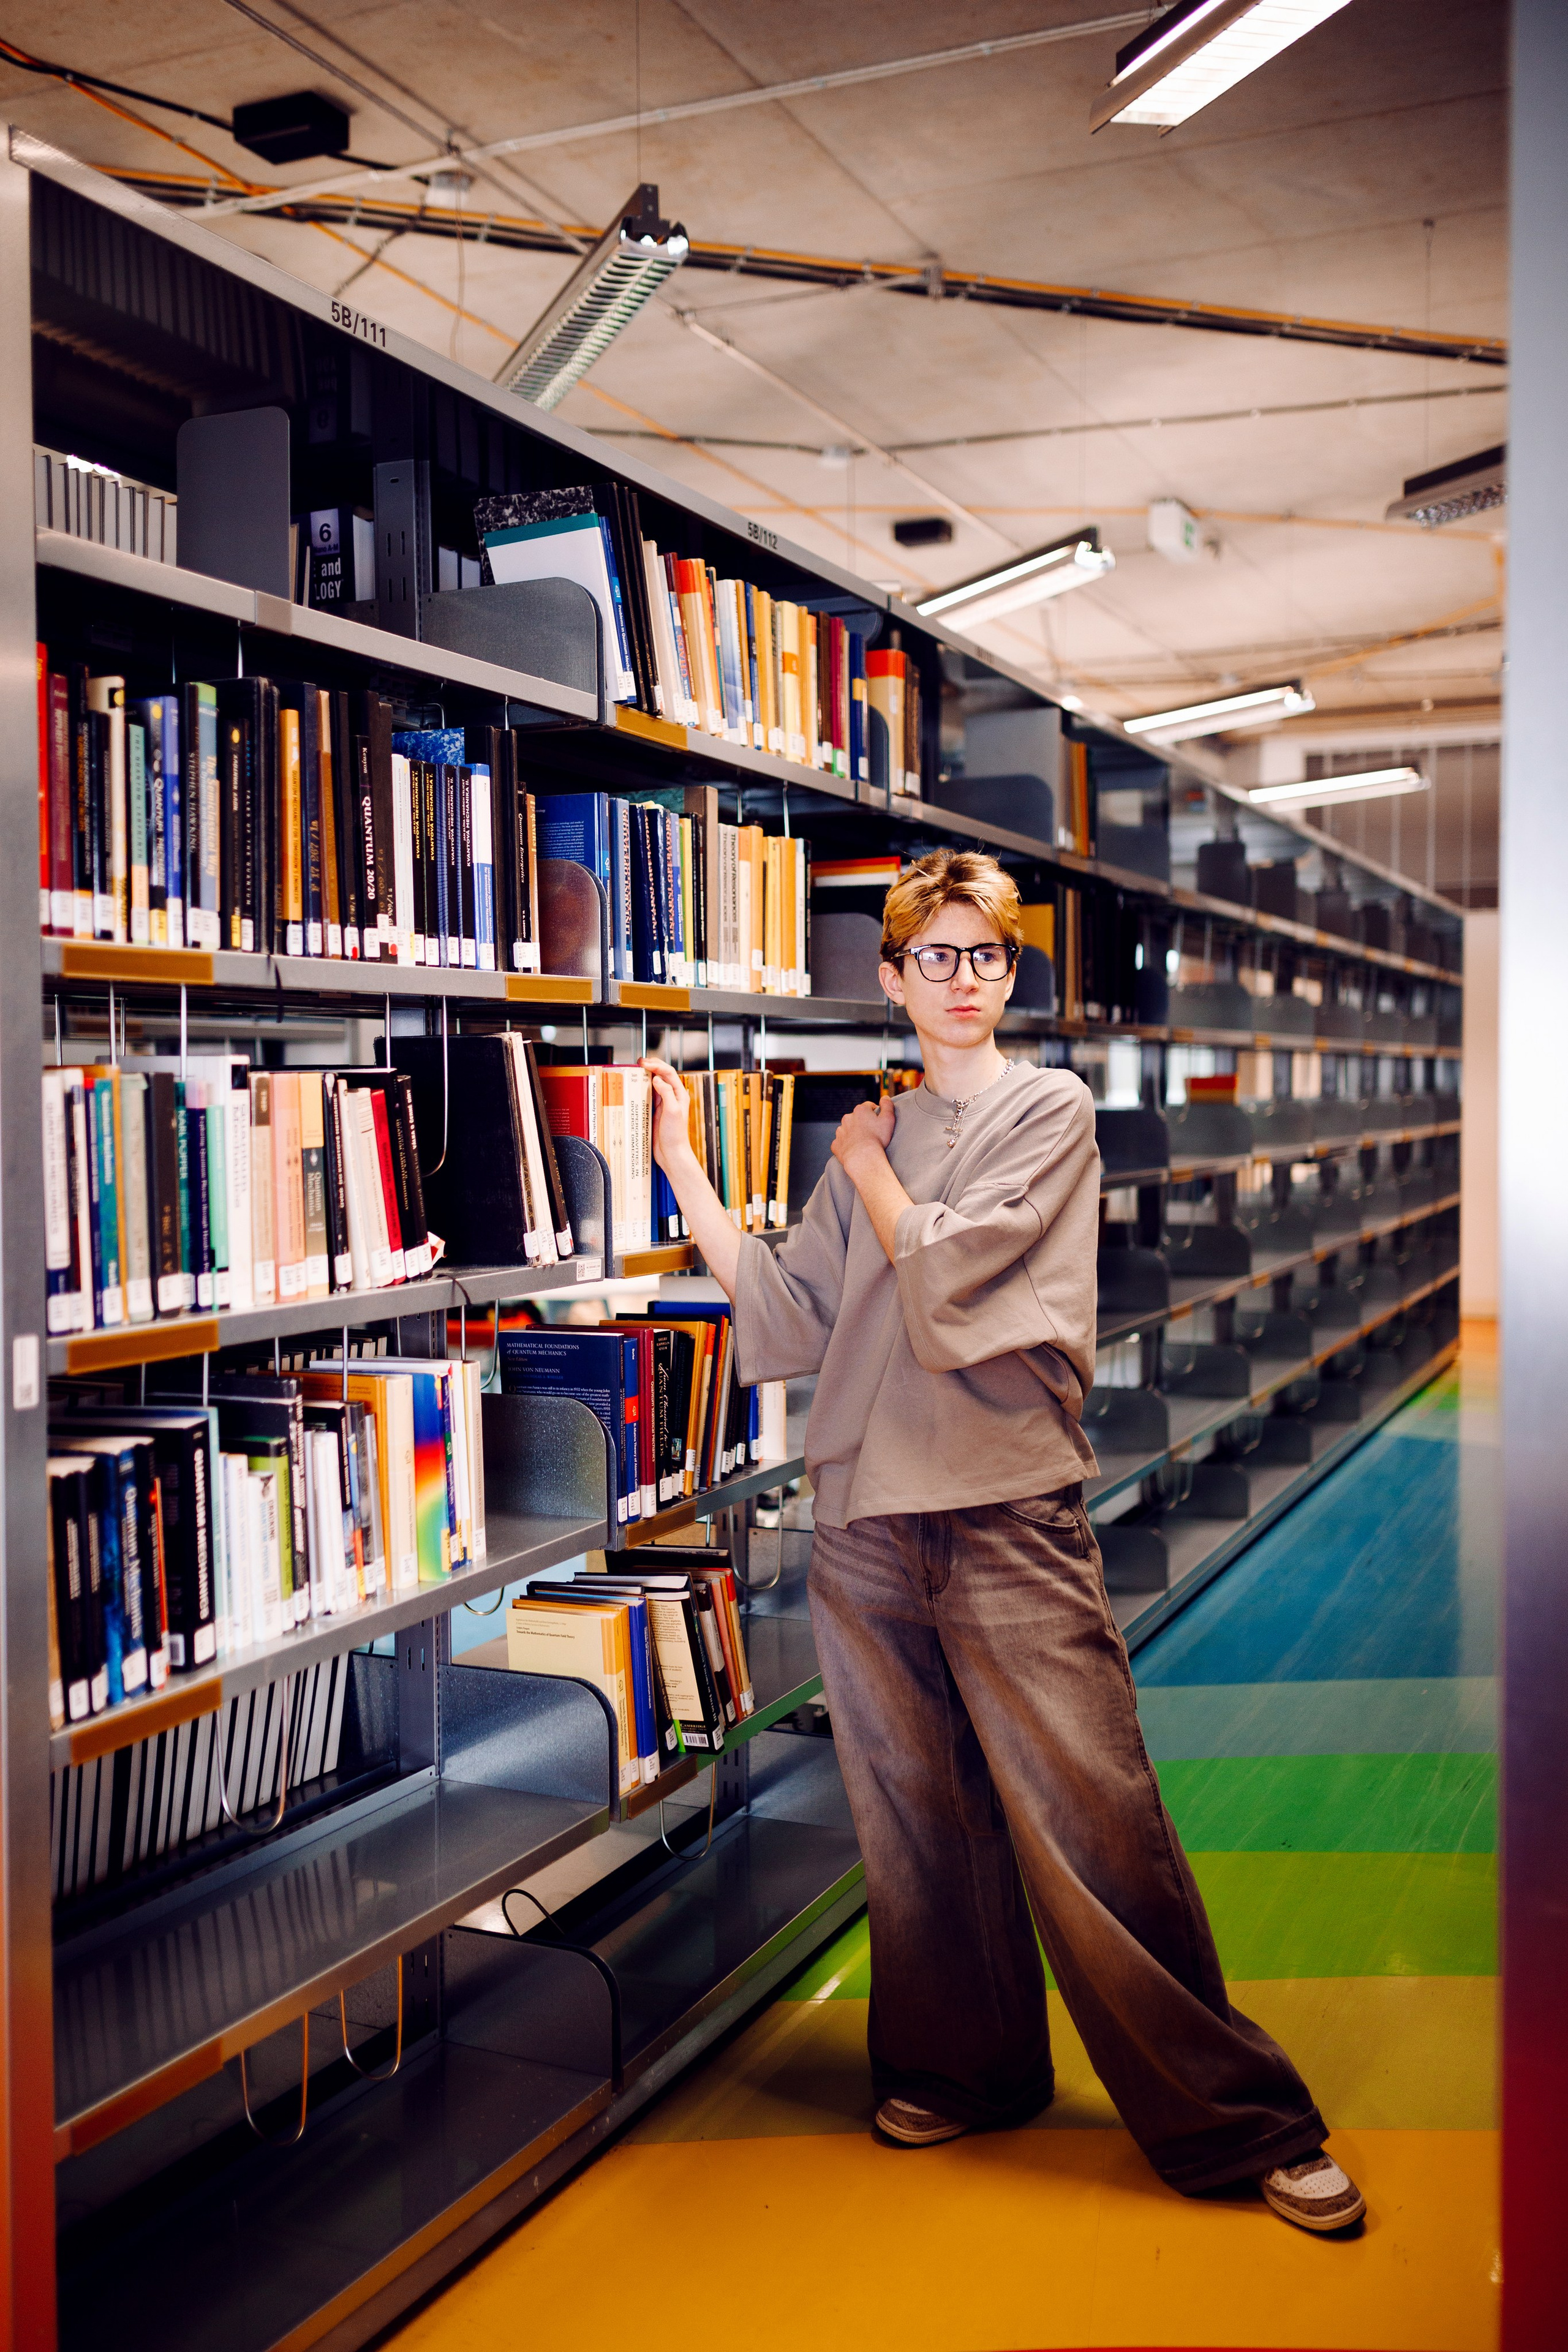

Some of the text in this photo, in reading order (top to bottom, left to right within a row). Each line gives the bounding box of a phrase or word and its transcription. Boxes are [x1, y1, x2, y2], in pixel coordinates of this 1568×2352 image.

[331, 302, 386, 347] 5B/111
[320, 523, 331, 542] 6
[748, 522, 777, 549] 5B/112
[322, 557, 341, 576] and
[677, 635, 688, 677] CHAOS
[206, 755, 217, 774] The
[362, 796, 374, 865] QUANTUM
[206, 855, 217, 878] Way
[366, 869, 375, 900] 20/20
[178, 1110, 187, 1137] KARL
[307, 1172, 315, 1216] Mechanics
[194, 1448, 210, 1620] QUANTUM MECHANICS
